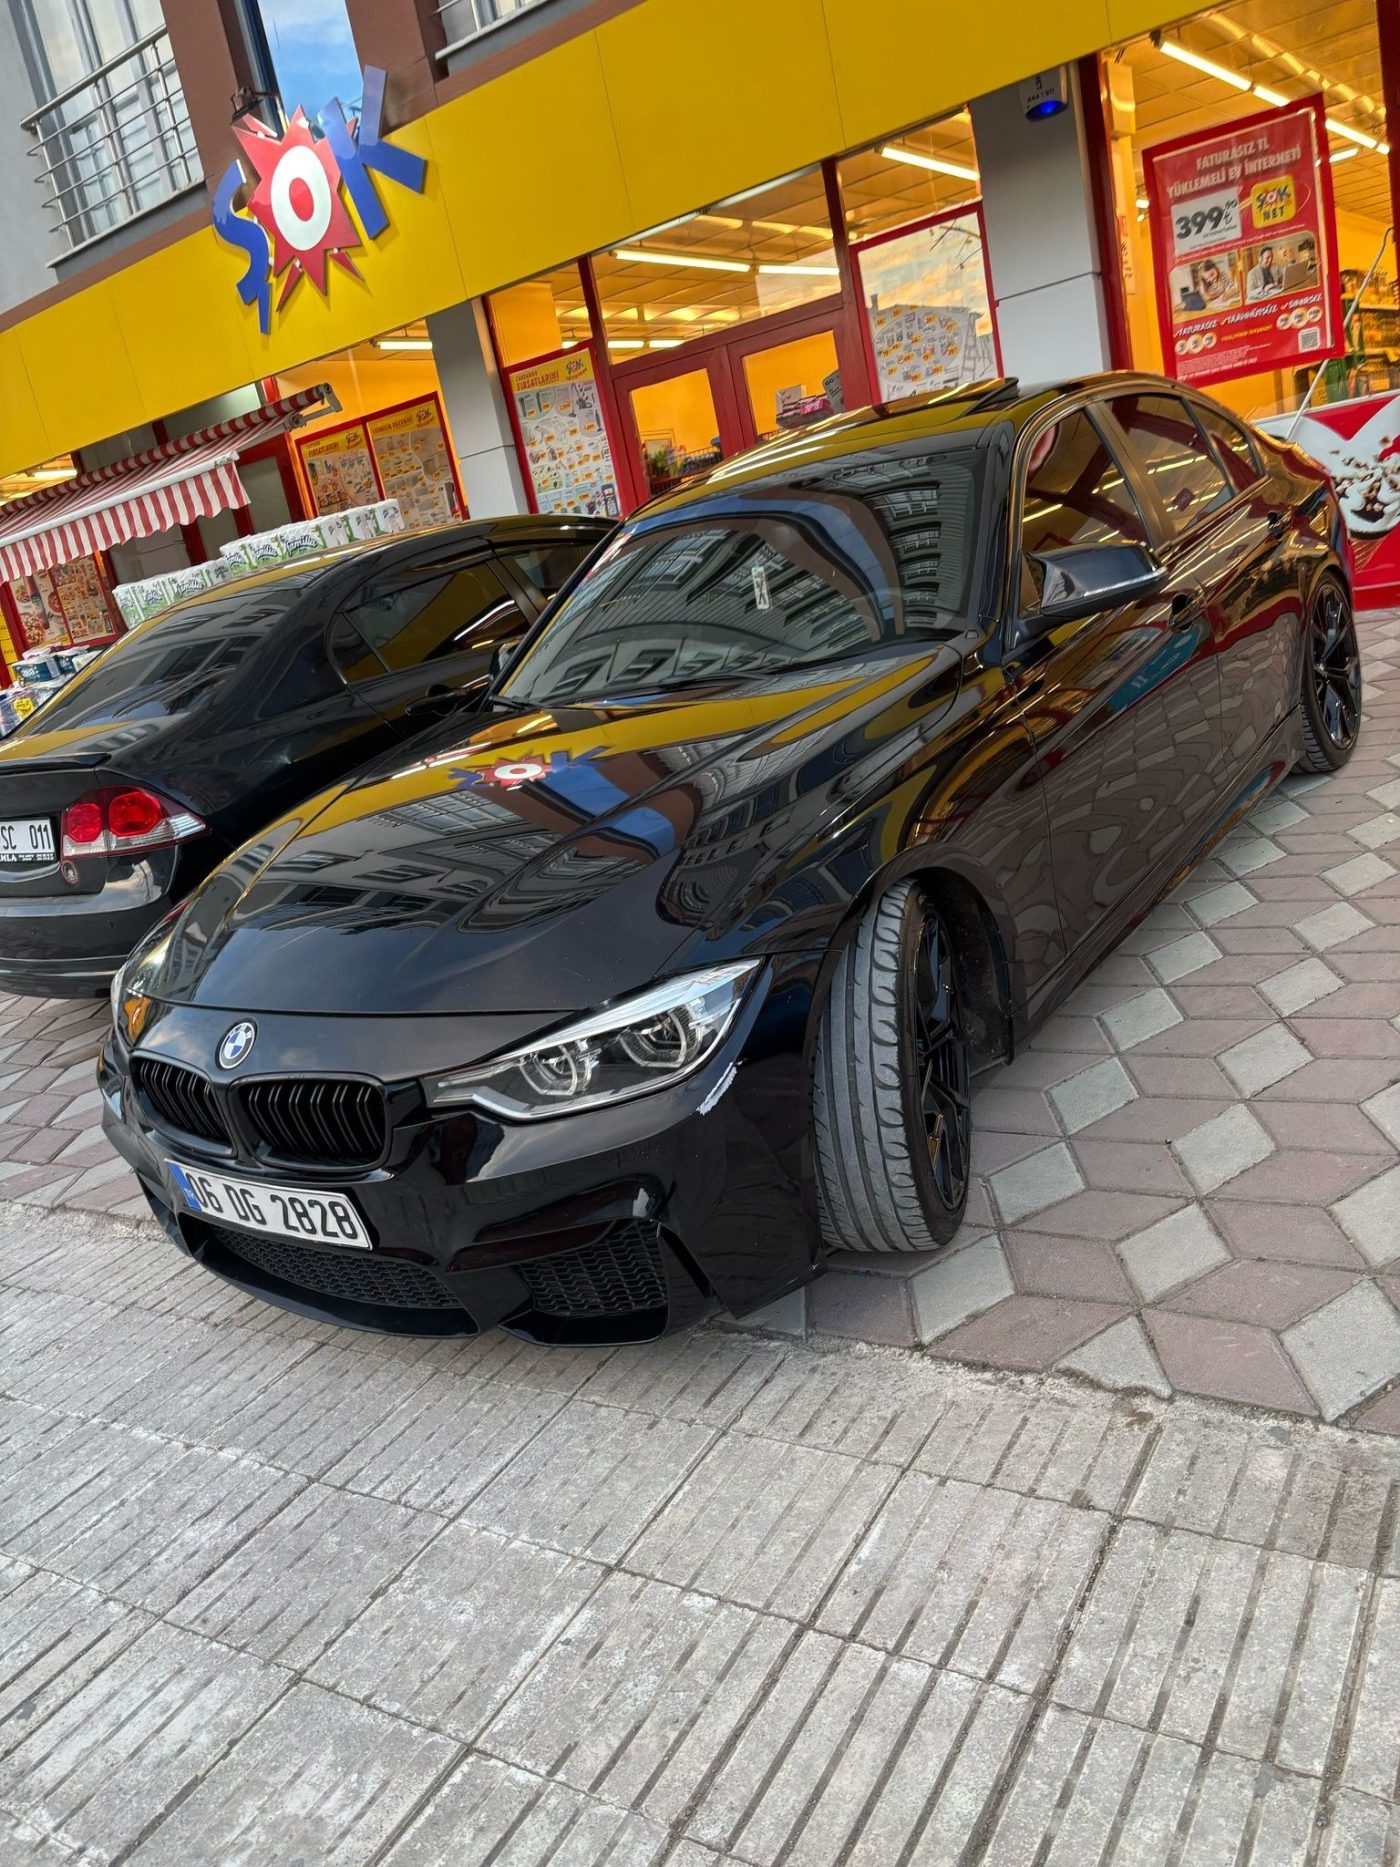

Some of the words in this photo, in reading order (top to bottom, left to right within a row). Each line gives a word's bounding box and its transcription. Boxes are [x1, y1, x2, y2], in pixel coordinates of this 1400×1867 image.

[1196, 139, 1256, 171] FATURASIZ
[1258, 137, 1270, 152] TL
[1167, 167, 1226, 198] YÜKLEMELİ
[1228, 163, 1243, 180] EV
[212, 64, 426, 335] ŞOK
[1262, 205, 1285, 222] NET
[1, 825, 17, 850] SC
[29, 824, 52, 850] 011
[185, 1172, 224, 1213] 06
[222, 1182, 267, 1226] DG
[269, 1193, 358, 1240] 2828
